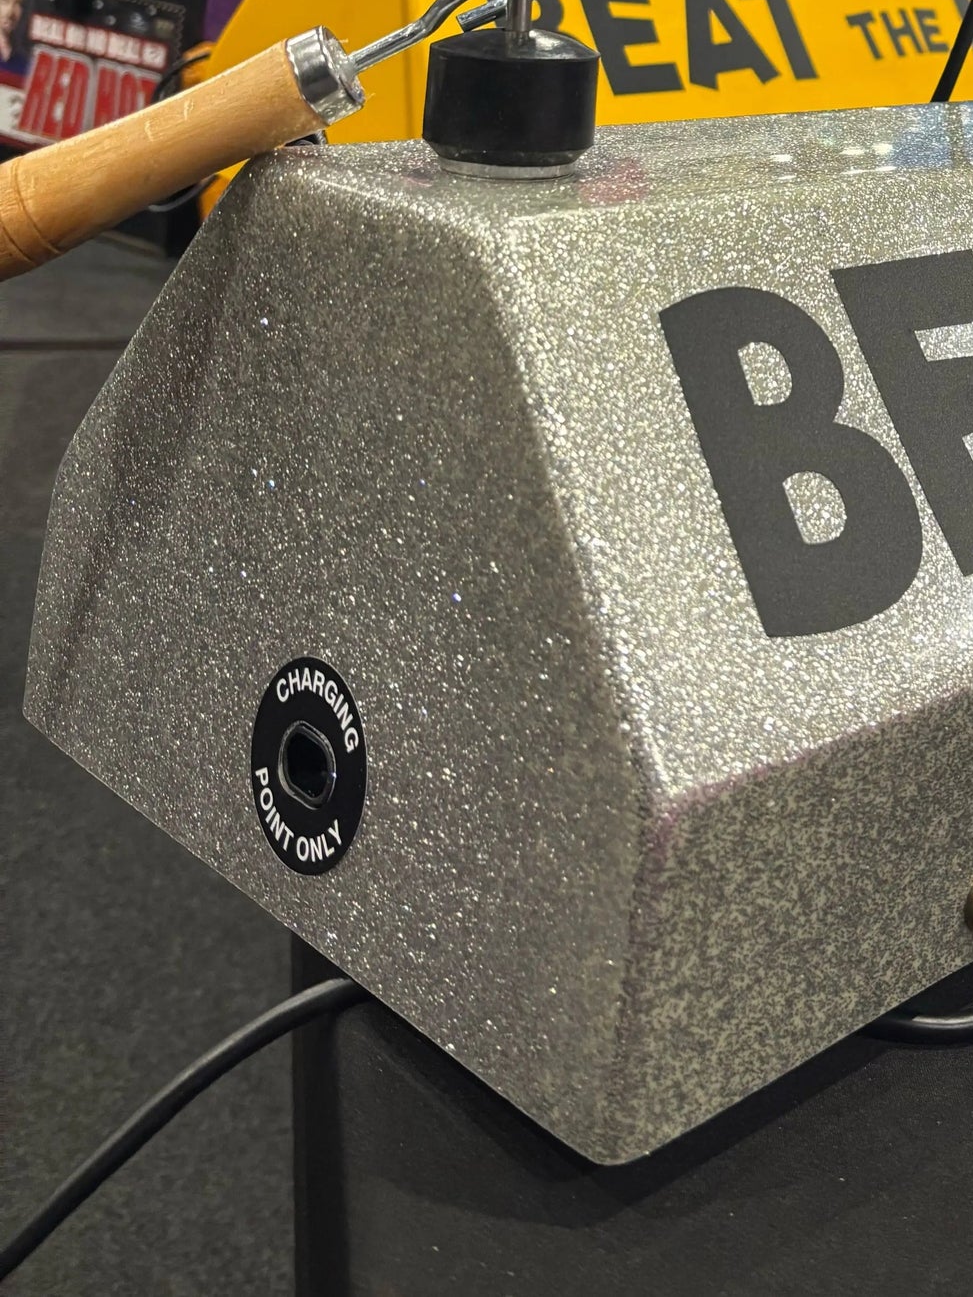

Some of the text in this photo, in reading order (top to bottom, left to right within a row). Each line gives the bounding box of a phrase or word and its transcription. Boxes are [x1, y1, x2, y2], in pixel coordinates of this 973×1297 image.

[845, 7, 949, 60] THE
[18, 50, 90, 140] RED
[276, 666, 359, 754] CHARGING
[255, 765, 343, 863] POINT ONLY
